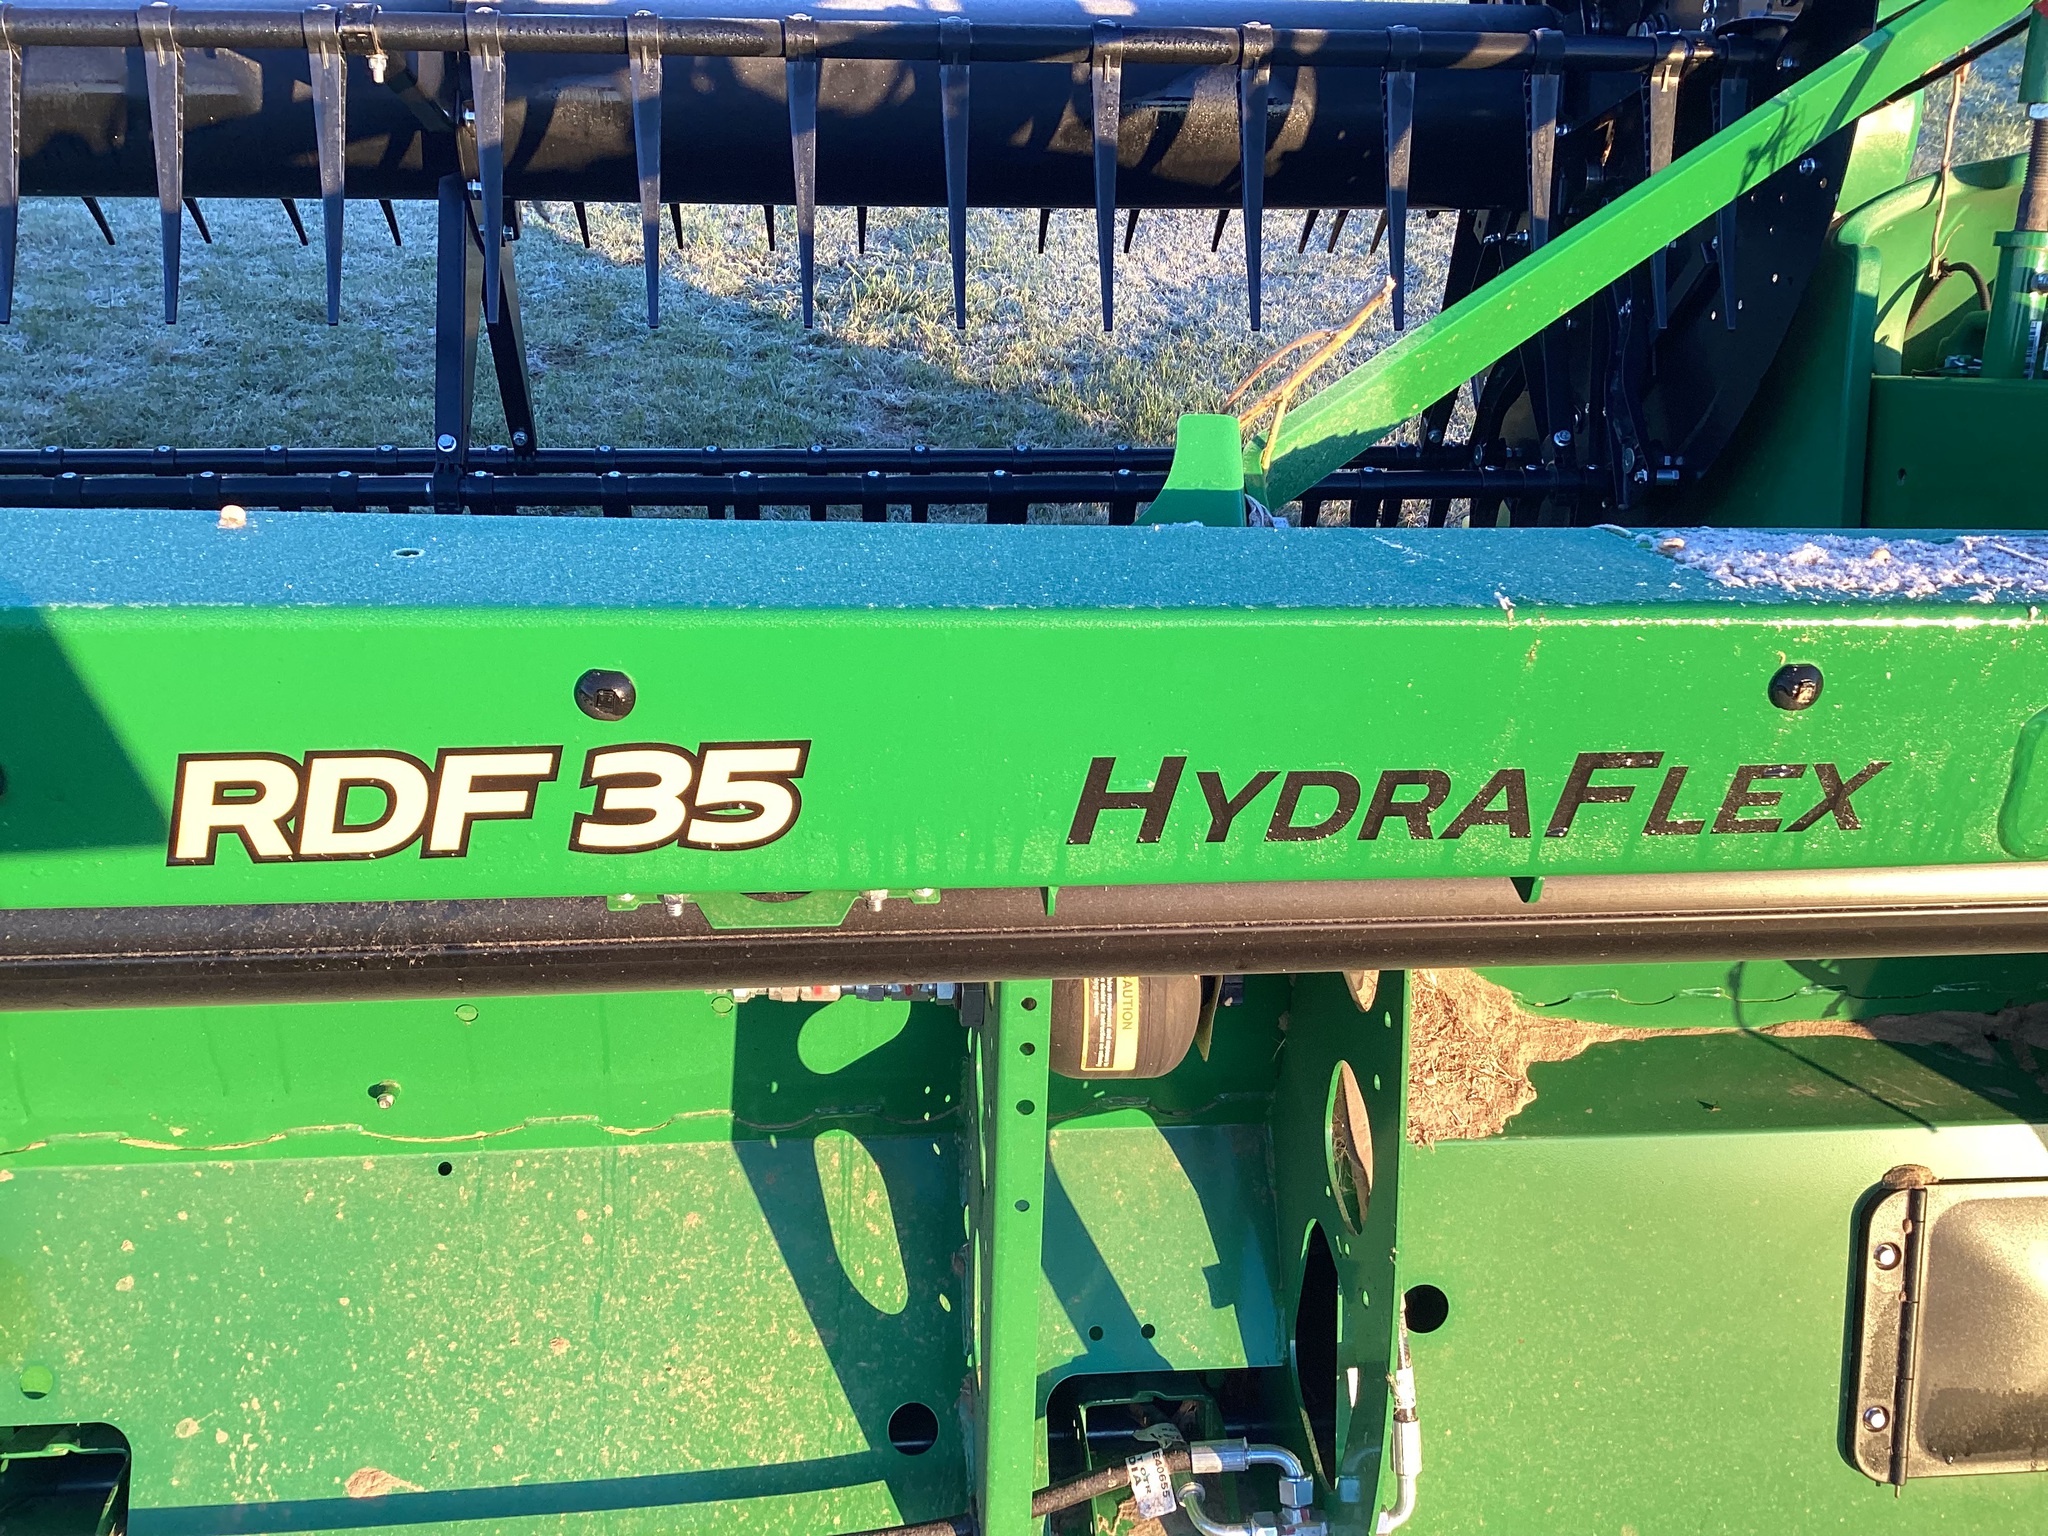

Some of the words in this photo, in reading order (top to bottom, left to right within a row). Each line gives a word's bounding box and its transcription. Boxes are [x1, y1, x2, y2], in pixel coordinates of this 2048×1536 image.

[167, 745, 563, 866] RDF
[569, 740, 811, 853] 35
[1065, 751, 1891, 844] HYDRAFLEX
[1152, 1450, 1171, 1498] E40655
